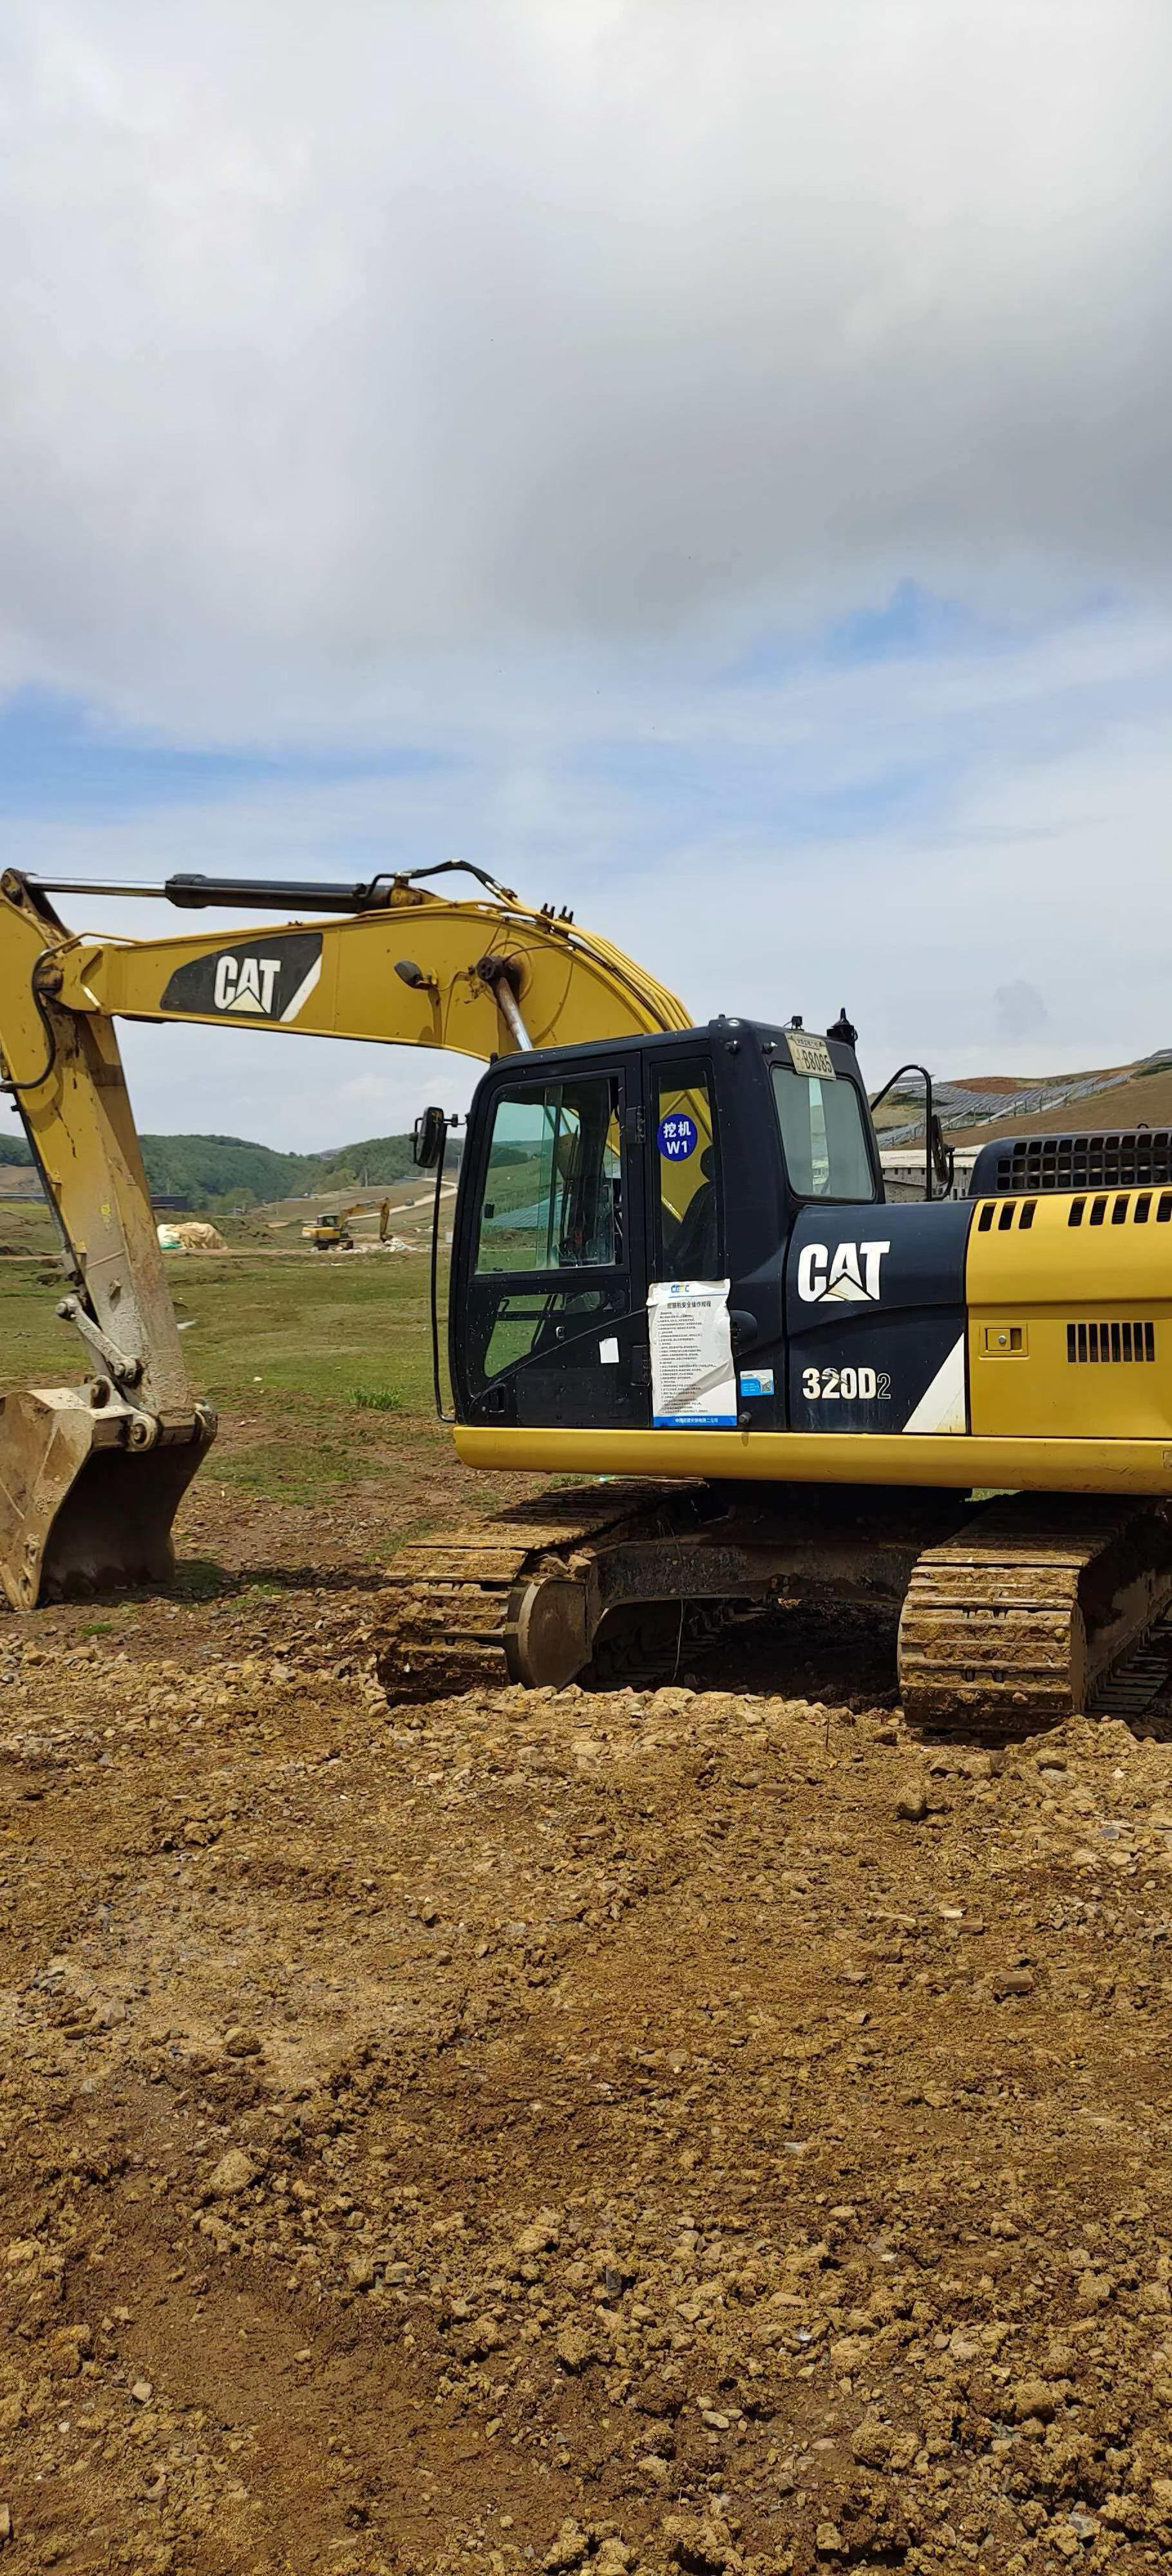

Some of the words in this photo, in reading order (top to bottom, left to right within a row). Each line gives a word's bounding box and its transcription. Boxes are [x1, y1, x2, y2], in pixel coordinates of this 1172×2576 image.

[214, 956, 281, 1014] CAT
[663, 1121, 692, 1139] 挖机
[666, 1141, 688, 1155] W1
[798, 1241, 891, 1302] CAT
